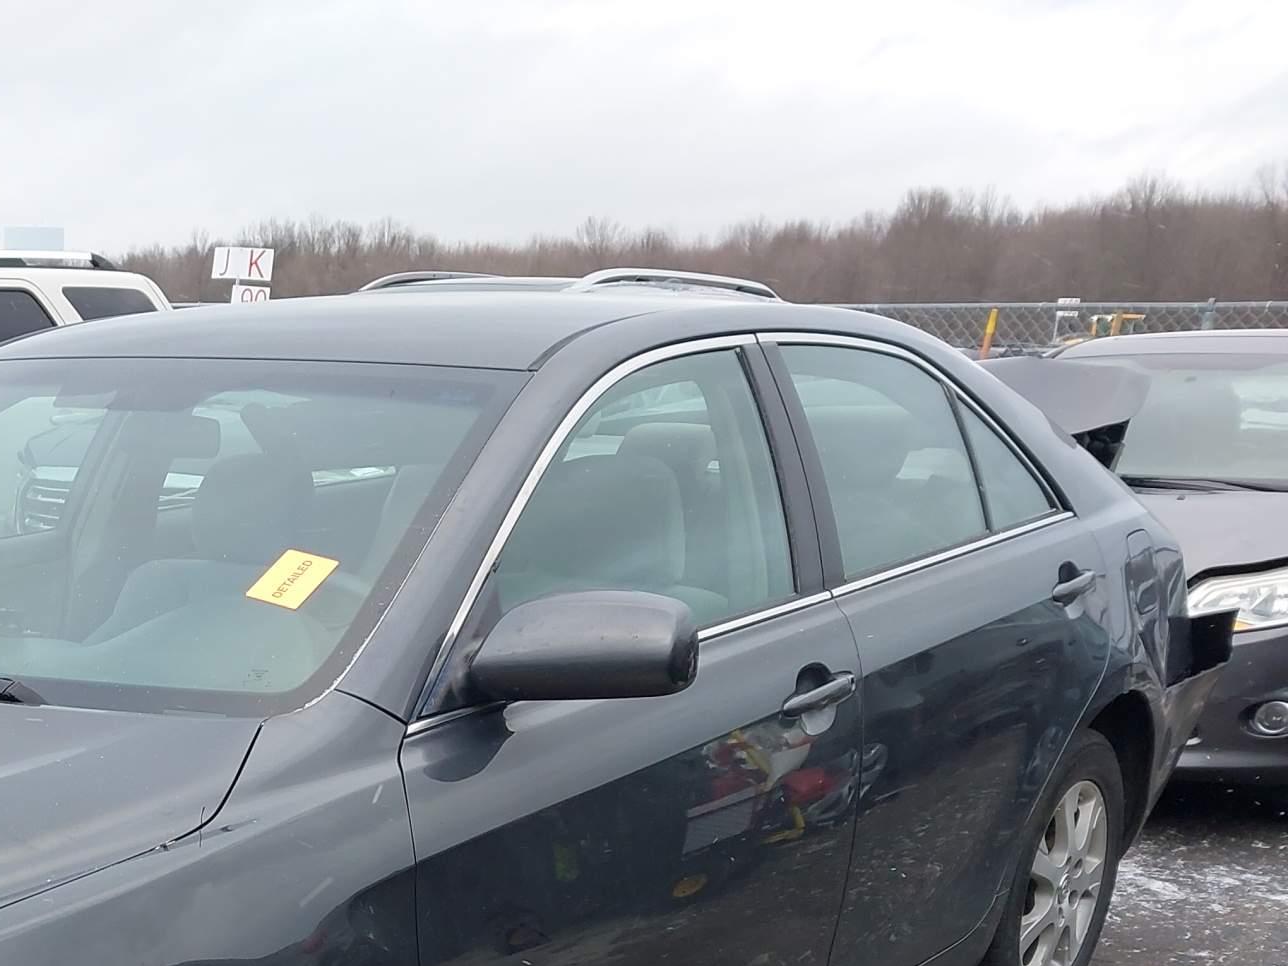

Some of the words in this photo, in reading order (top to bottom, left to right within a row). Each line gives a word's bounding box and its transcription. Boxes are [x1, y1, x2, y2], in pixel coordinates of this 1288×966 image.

[219, 249, 230, 277] J
[248, 249, 266, 278] K
[273, 560, 313, 598] DETAILED
